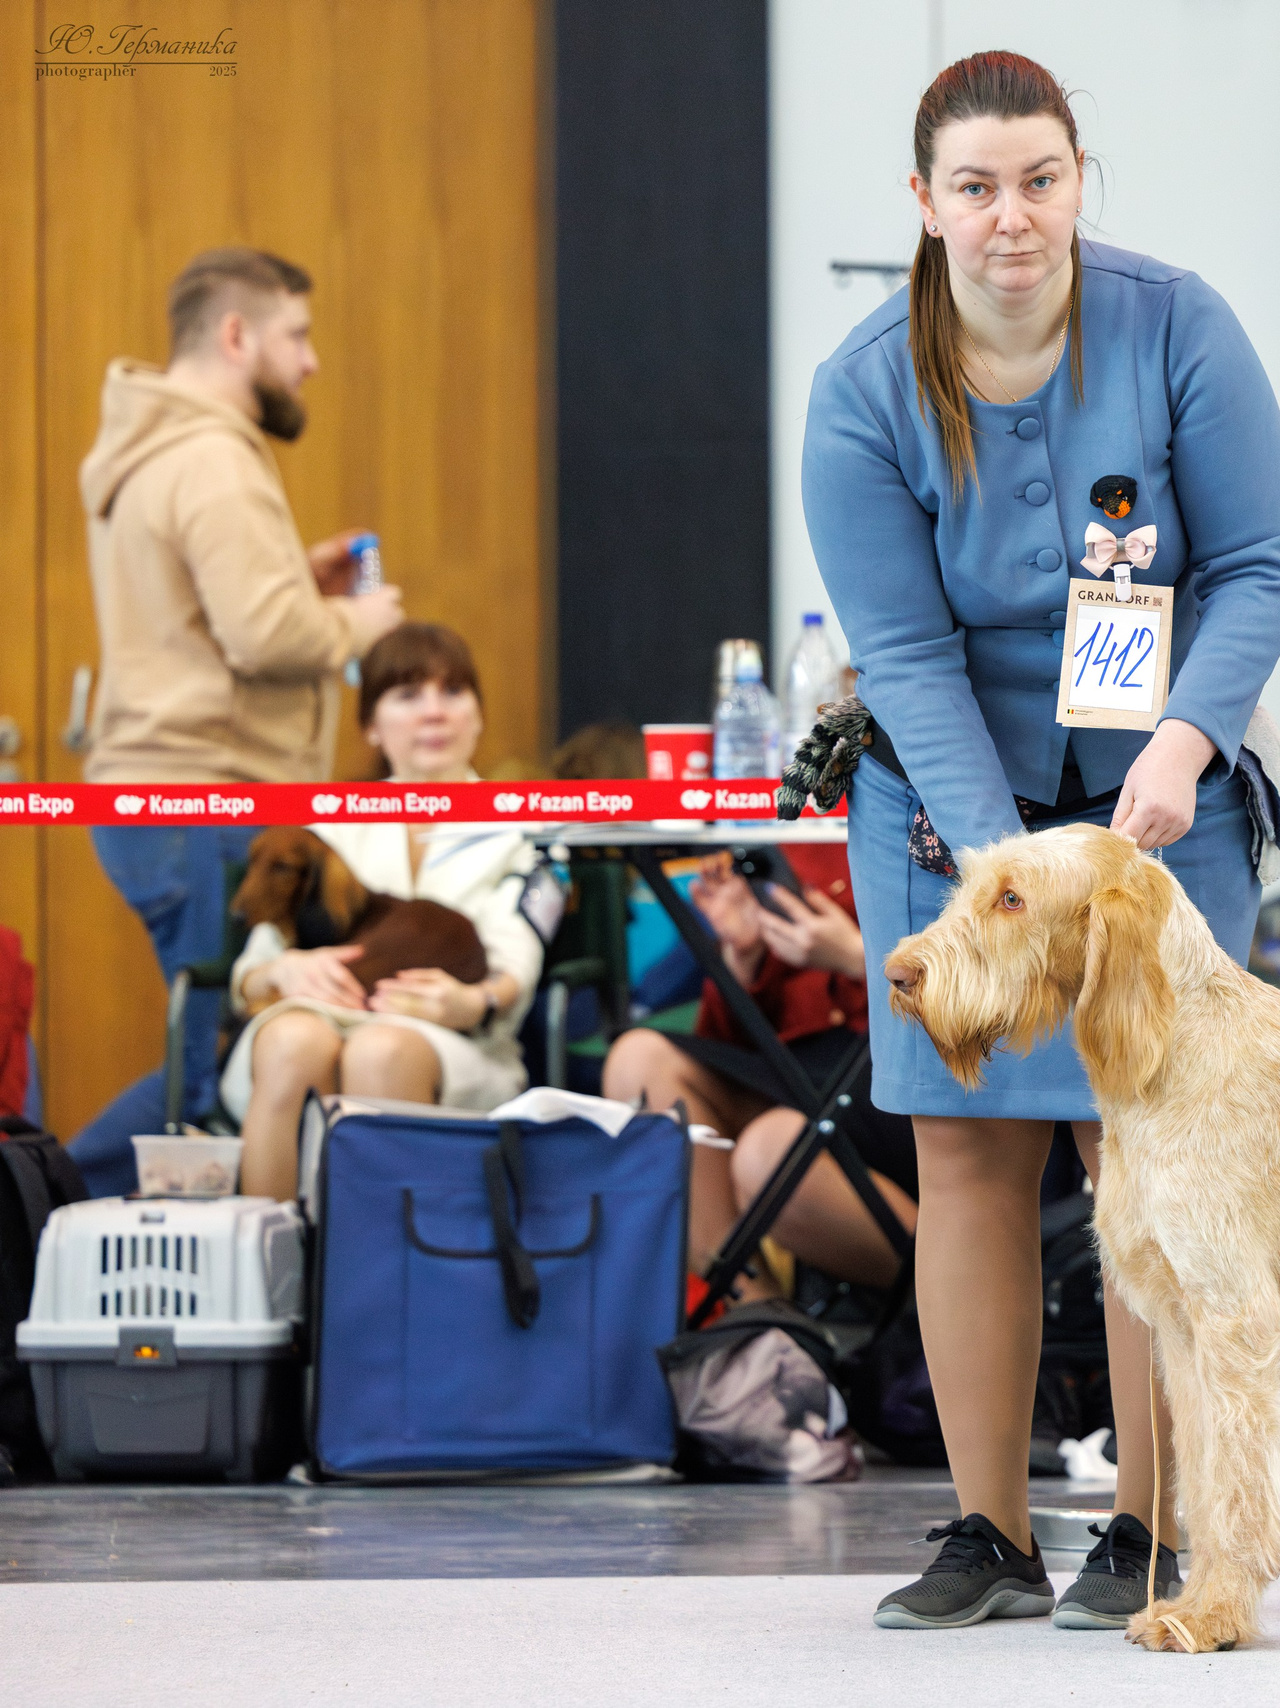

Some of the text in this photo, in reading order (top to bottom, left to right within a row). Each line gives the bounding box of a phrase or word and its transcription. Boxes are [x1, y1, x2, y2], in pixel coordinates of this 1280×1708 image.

[1078, 590, 1150, 605] GRANORF
[1074, 621, 1154, 687] 1412
[28, 793, 75, 818] Expo
[149, 794, 255, 818] Kazan Expo
[345, 792, 452, 816] Kazan Expo
[528, 791, 633, 815] Kazan Expo
[715, 790, 772, 809] Kazan
